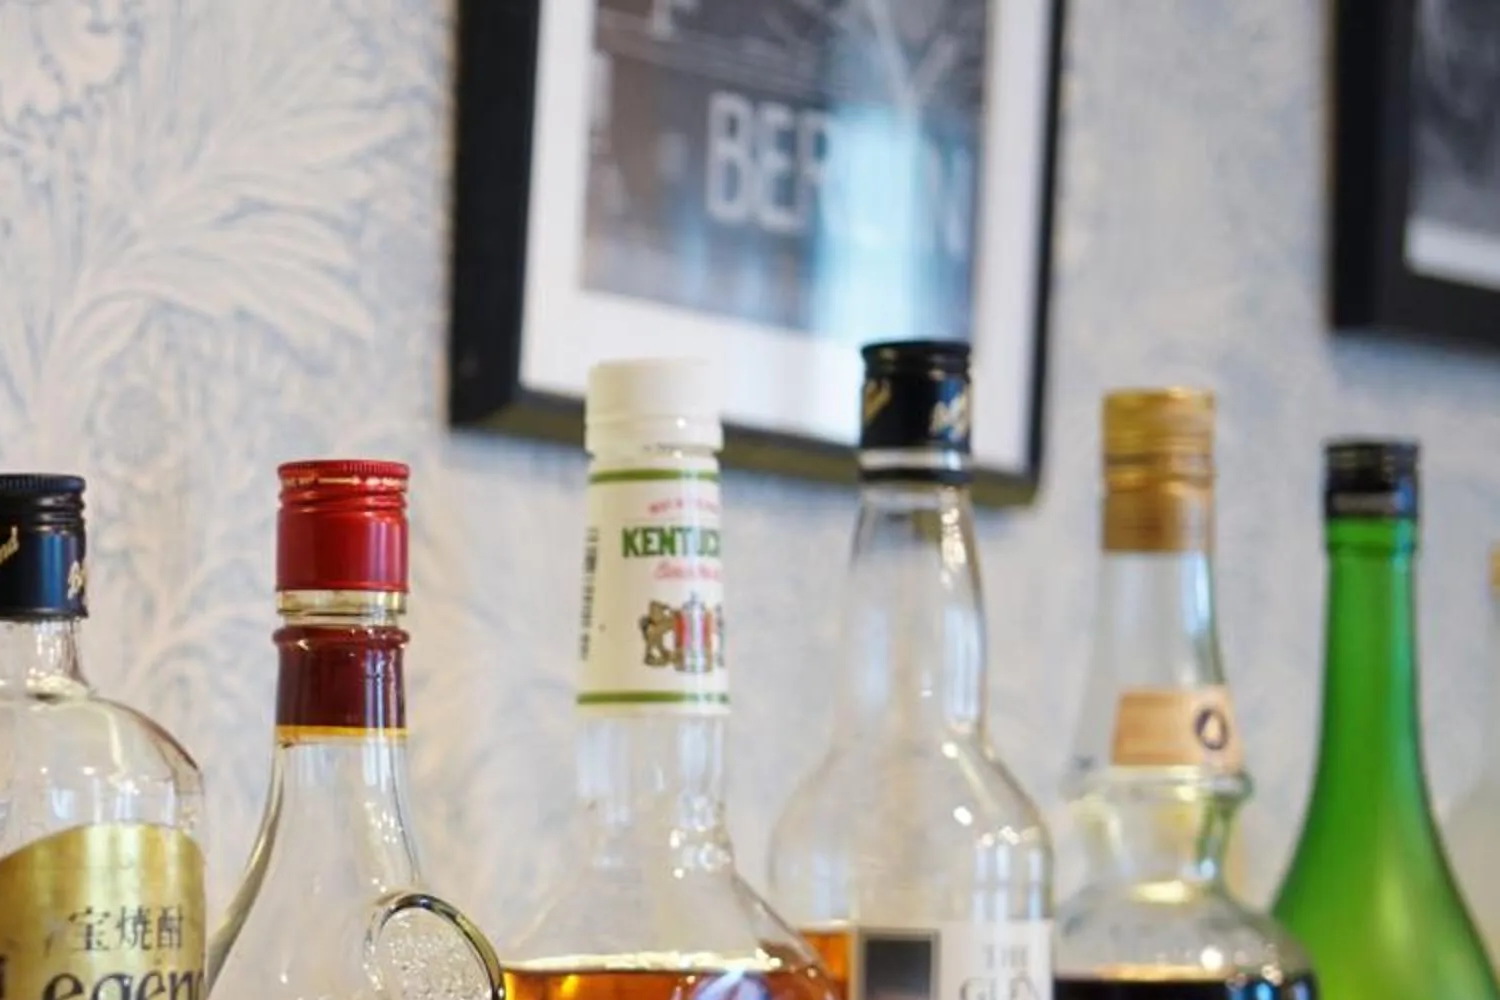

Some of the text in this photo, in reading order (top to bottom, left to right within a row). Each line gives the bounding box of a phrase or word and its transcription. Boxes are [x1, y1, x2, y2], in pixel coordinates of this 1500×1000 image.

[706, 90, 968, 260] BERN
[621, 526, 720, 559] KENTUC
[68, 904, 184, 951] 宝焼酎
